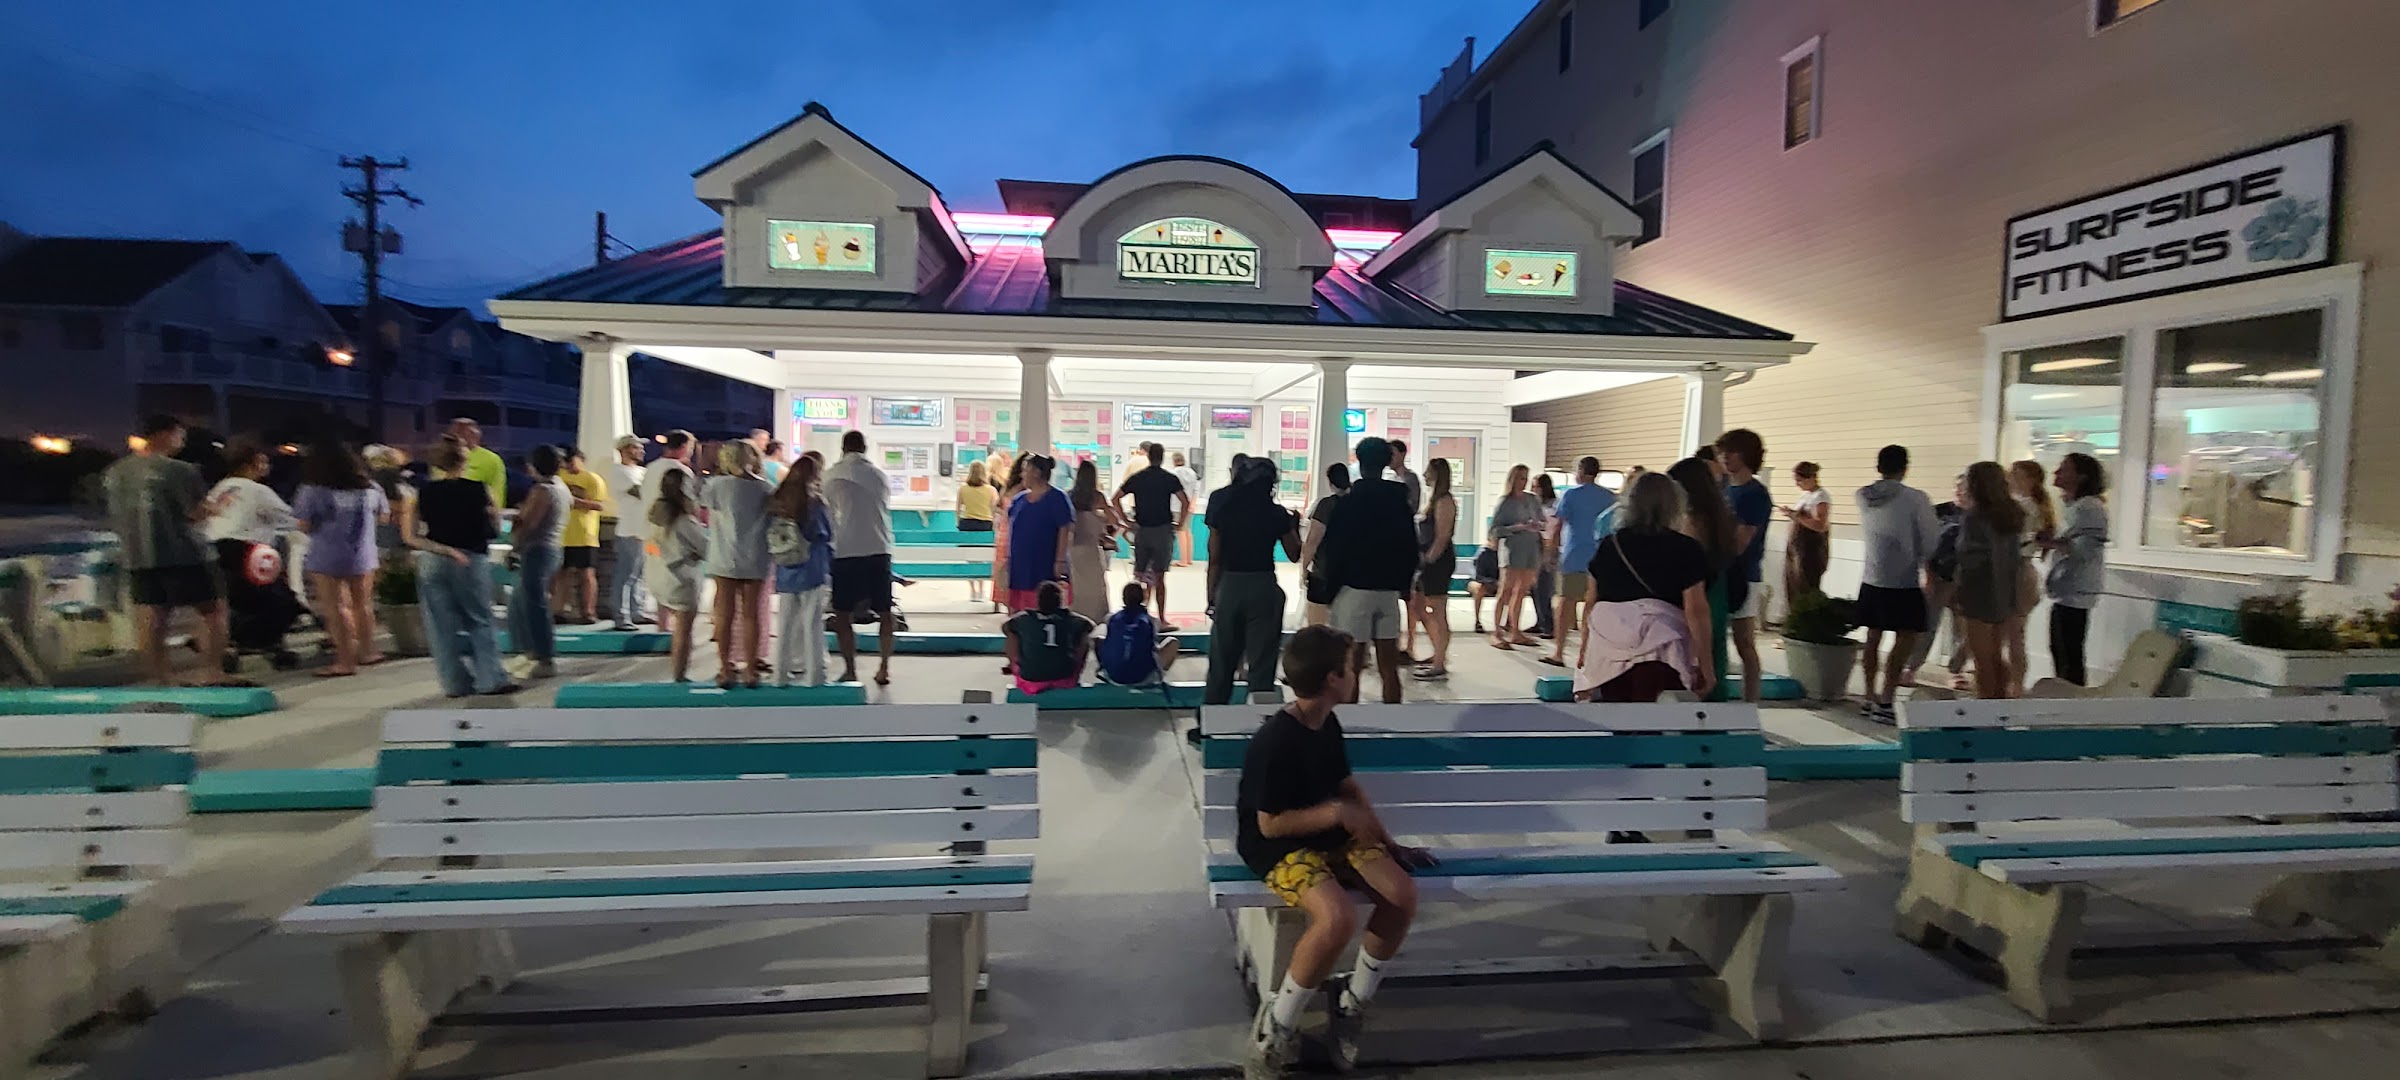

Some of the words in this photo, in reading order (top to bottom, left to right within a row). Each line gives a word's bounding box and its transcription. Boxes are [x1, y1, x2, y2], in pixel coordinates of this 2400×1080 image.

[2014, 165, 2285, 260] SURFSIDE
[1128, 251, 1251, 277] MARITA'S
[2011, 229, 2232, 301] FITNESS
[808, 400, 843, 408] THANK
[1114, 454, 1122, 464] 2
[1043, 623, 1058, 647] 1
